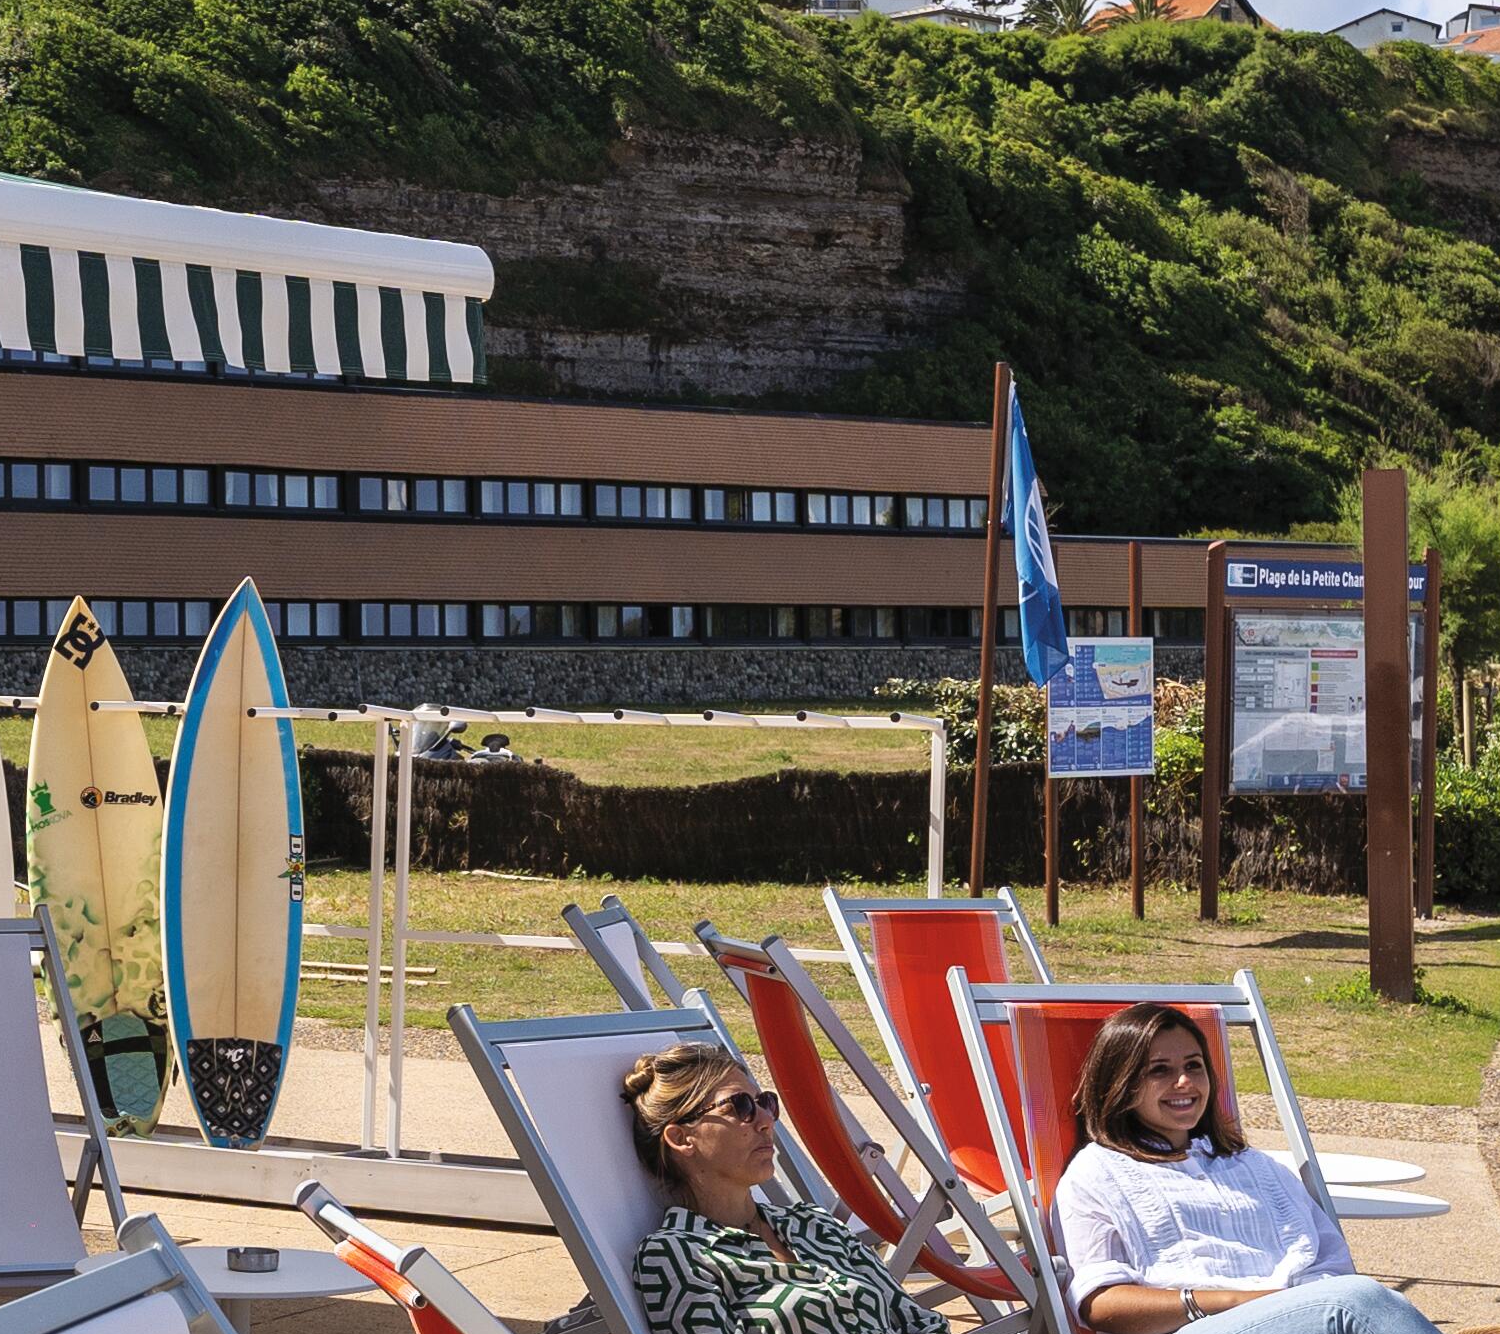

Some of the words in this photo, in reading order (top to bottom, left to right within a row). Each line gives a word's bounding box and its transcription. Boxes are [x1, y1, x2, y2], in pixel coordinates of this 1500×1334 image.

[1259, 568, 1286, 588] Plage
[1288, 569, 1300, 586] de
[1302, 569, 1311, 586] la
[1313, 570, 1341, 587] Petite
[104, 791, 158, 806] Bradley
